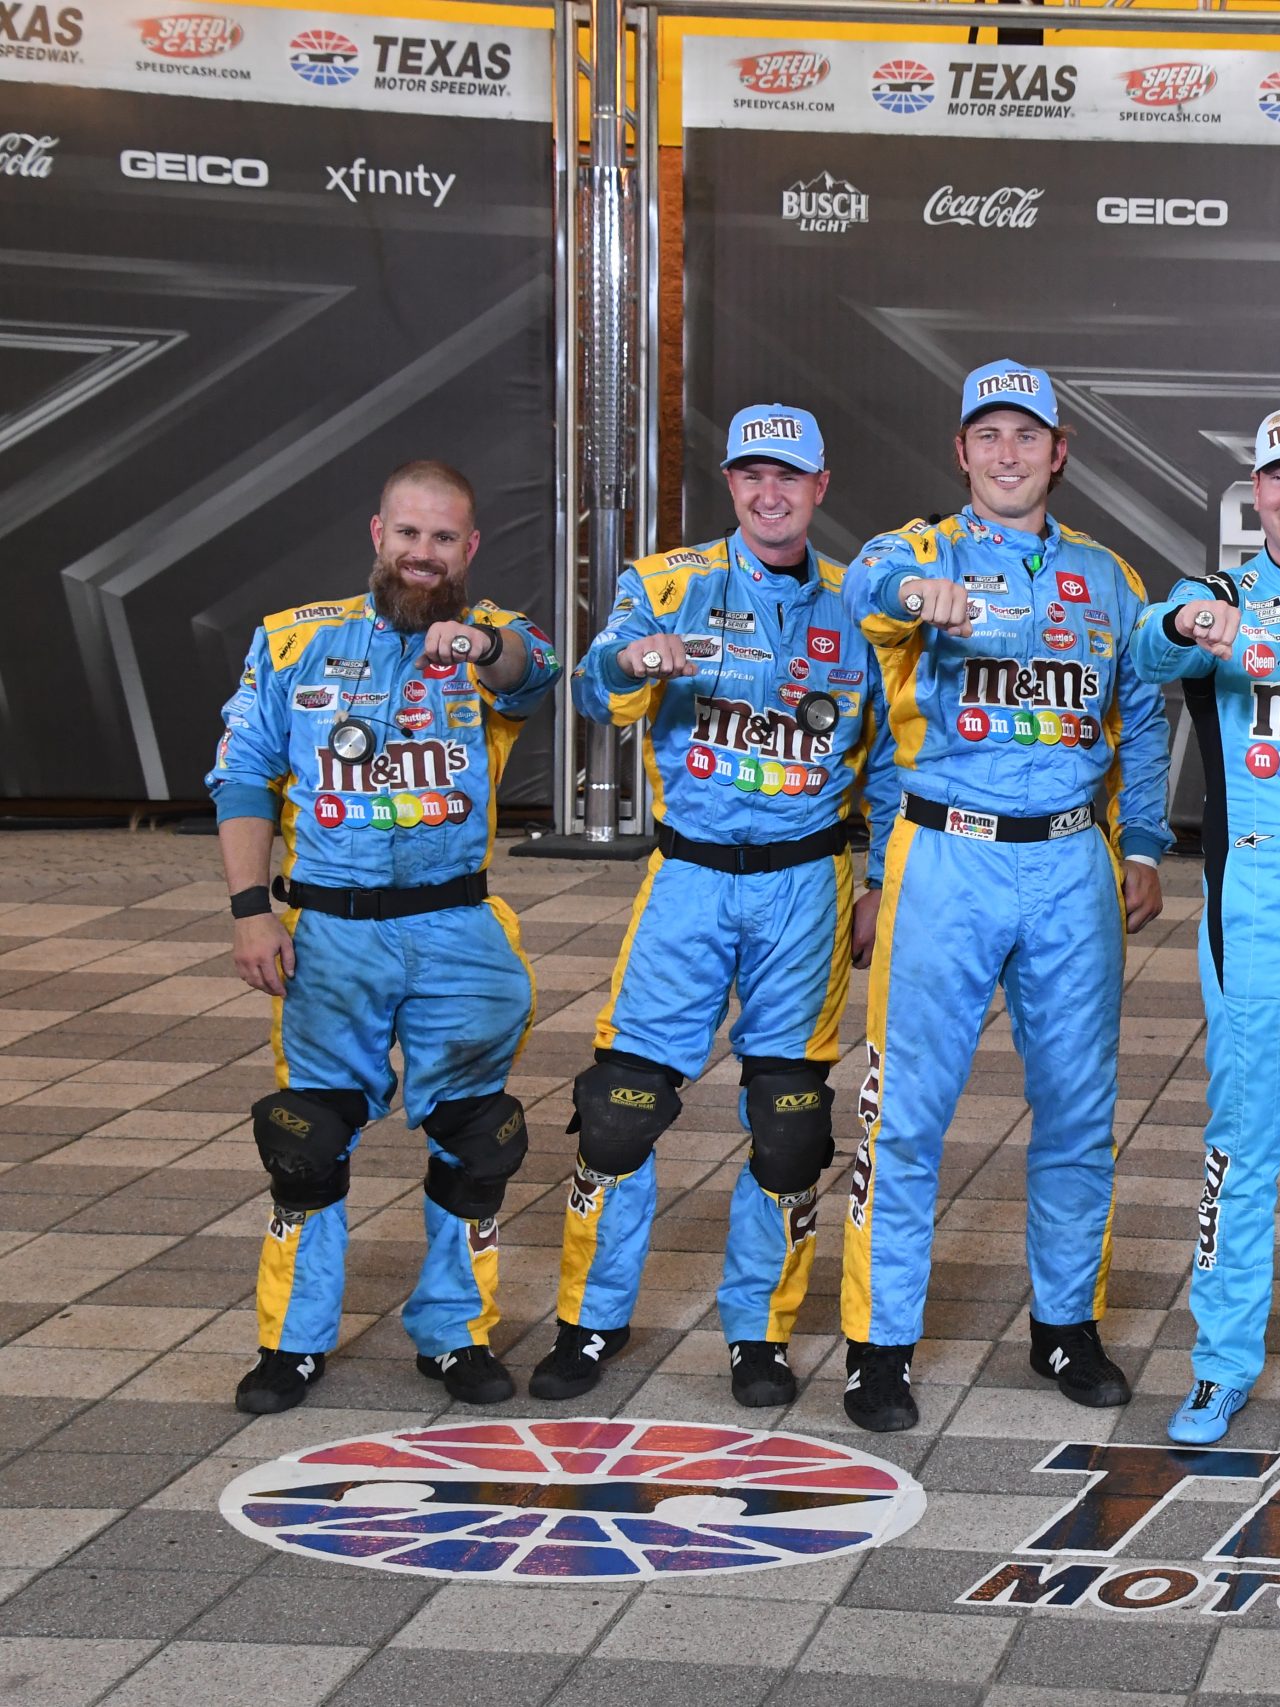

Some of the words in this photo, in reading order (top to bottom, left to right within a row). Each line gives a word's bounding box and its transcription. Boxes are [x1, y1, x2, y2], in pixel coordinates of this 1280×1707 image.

[159, 18, 236, 40] SPEEDY
[373, 35, 511, 80] TEXAS
[756, 53, 823, 76] SPEEDY
[136, 61, 252, 80] SPEEDYCASH.COM
[947, 62, 1078, 102] TEXAS
[1142, 63, 1215, 87] SPEEDY
[374, 76, 427, 93] MOTOR
[430, 80, 506, 98] SPEEDWAY
[733, 98, 835, 112] SPEEDYCASH.COM
[947, 102, 996, 117] MOTOR
[999, 103, 1072, 118] SPEEDWAY
[1119, 110, 1221, 124] SPEEDYCASH.COM
[120, 149, 269, 187] GEICO
[325, 157, 456, 208] xfinity
[782, 188, 869, 221] BUSCH
[1096, 198, 1228, 227] GEICO
[800, 219, 850, 233] LIGHT
[659, 579, 676, 605] IMPACT
[1246, 644, 1275, 673] Rheem
[398, 710, 432, 723] Skittles
